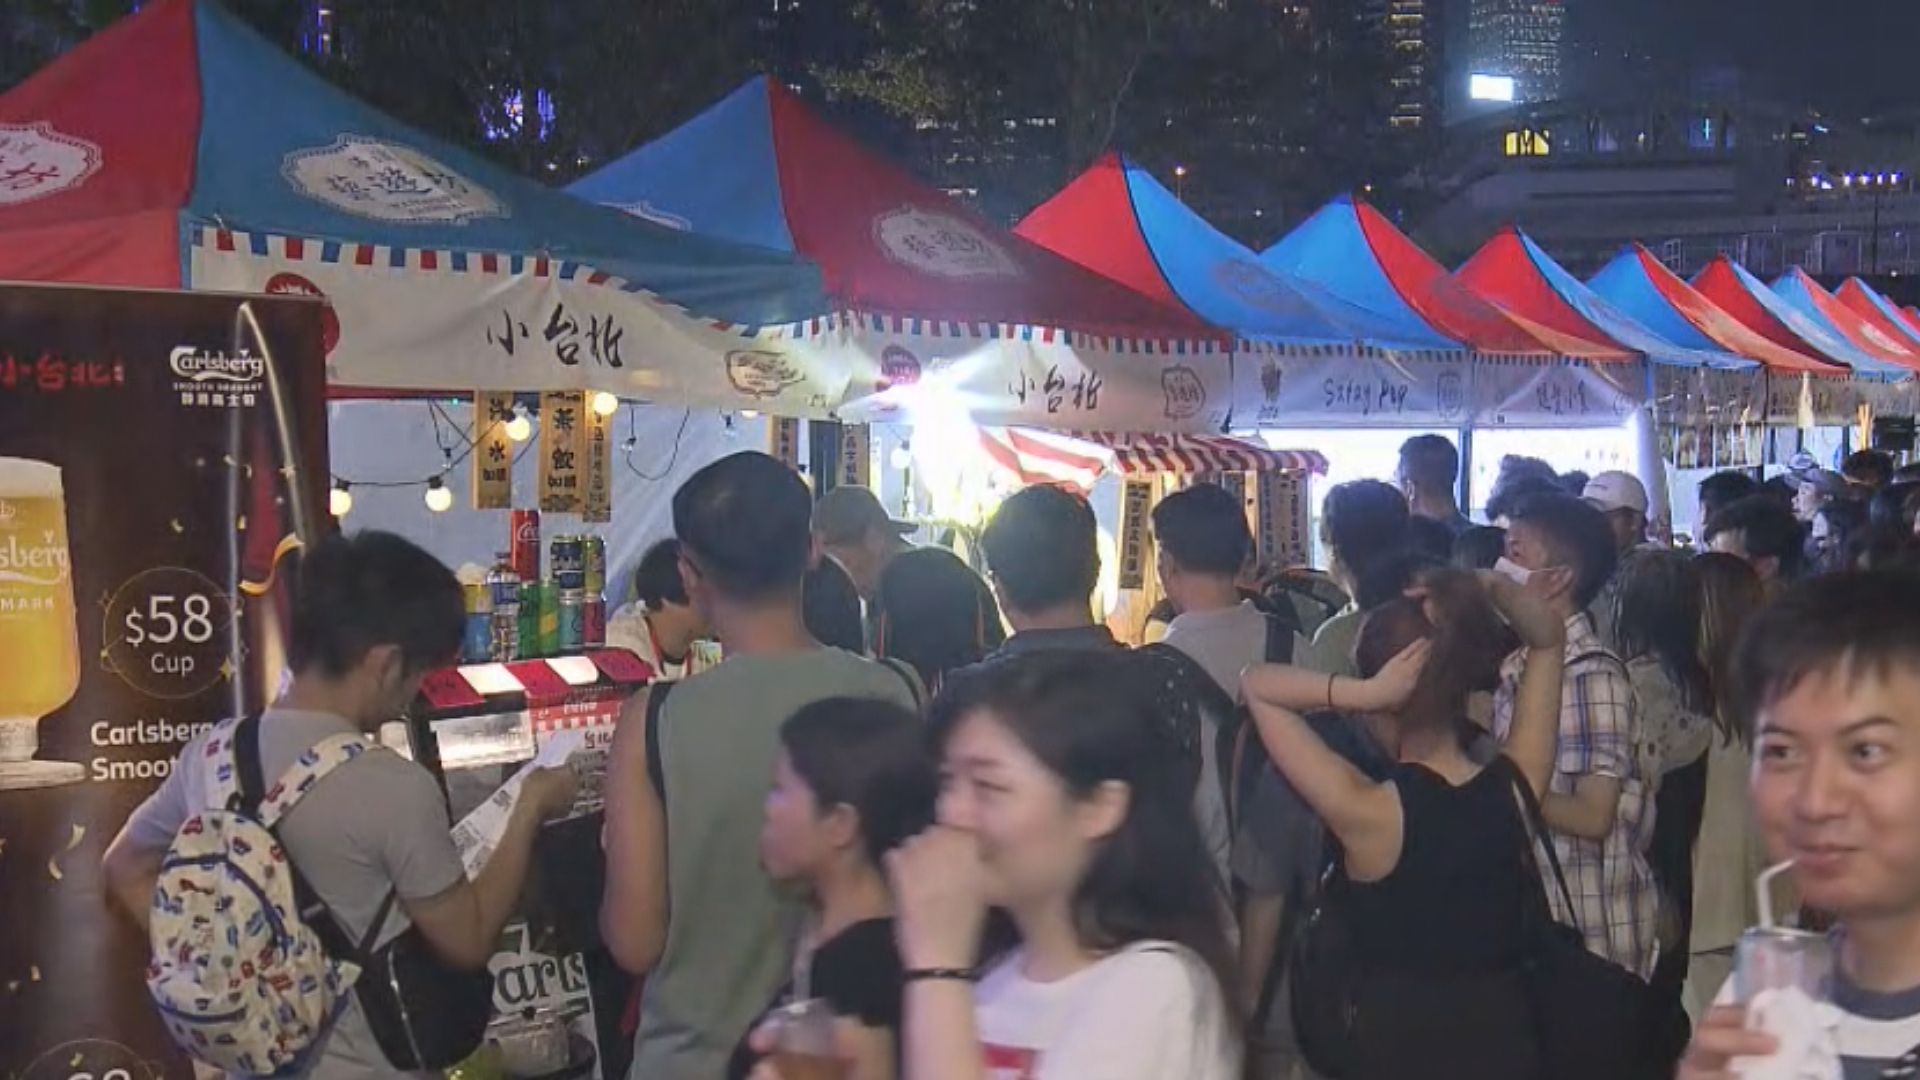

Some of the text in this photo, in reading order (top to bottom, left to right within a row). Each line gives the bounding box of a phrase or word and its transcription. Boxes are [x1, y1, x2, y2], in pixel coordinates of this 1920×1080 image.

[487, 302, 623, 368] 小台北
[169, 345, 264, 381] Carlsberg
[1009, 363, 1102, 413] 小台北
[125, 594, 213, 647] $58
[150, 653, 195, 677] Cup
